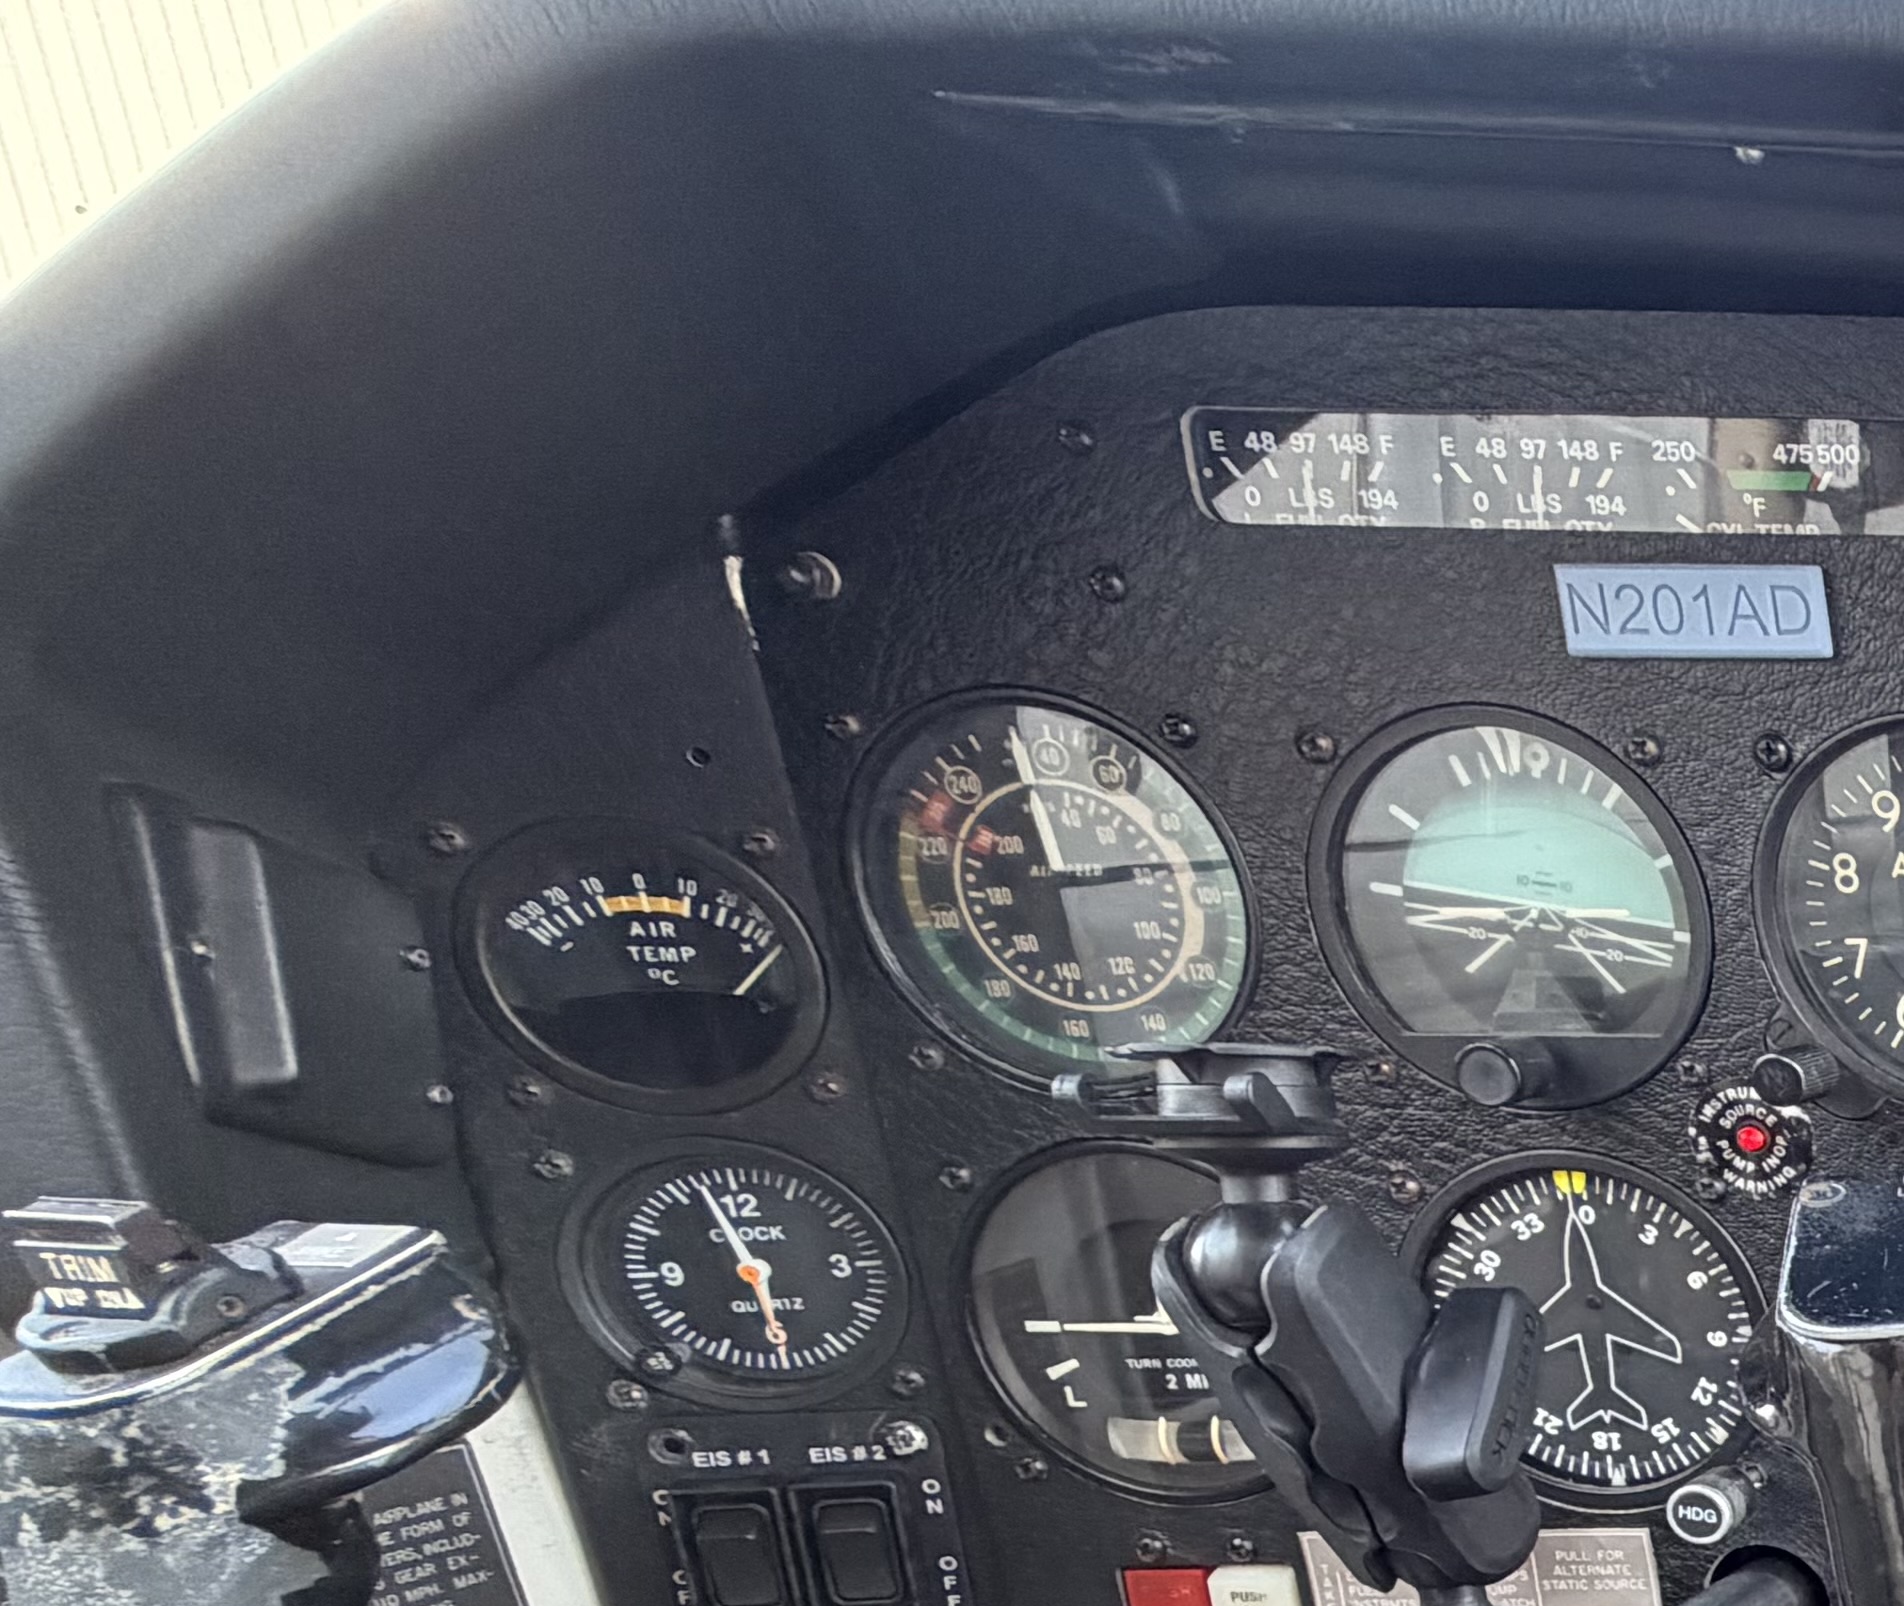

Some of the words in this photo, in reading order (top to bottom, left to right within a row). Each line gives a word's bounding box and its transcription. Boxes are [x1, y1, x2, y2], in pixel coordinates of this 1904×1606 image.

[1652, 441, 1695, 461] 250
[1565, 583, 1813, 637] N201AD
[629, 922, 676, 938] AIR
[627, 946, 696, 963] TEMP
[1678, 1505, 1718, 1524] HDG
